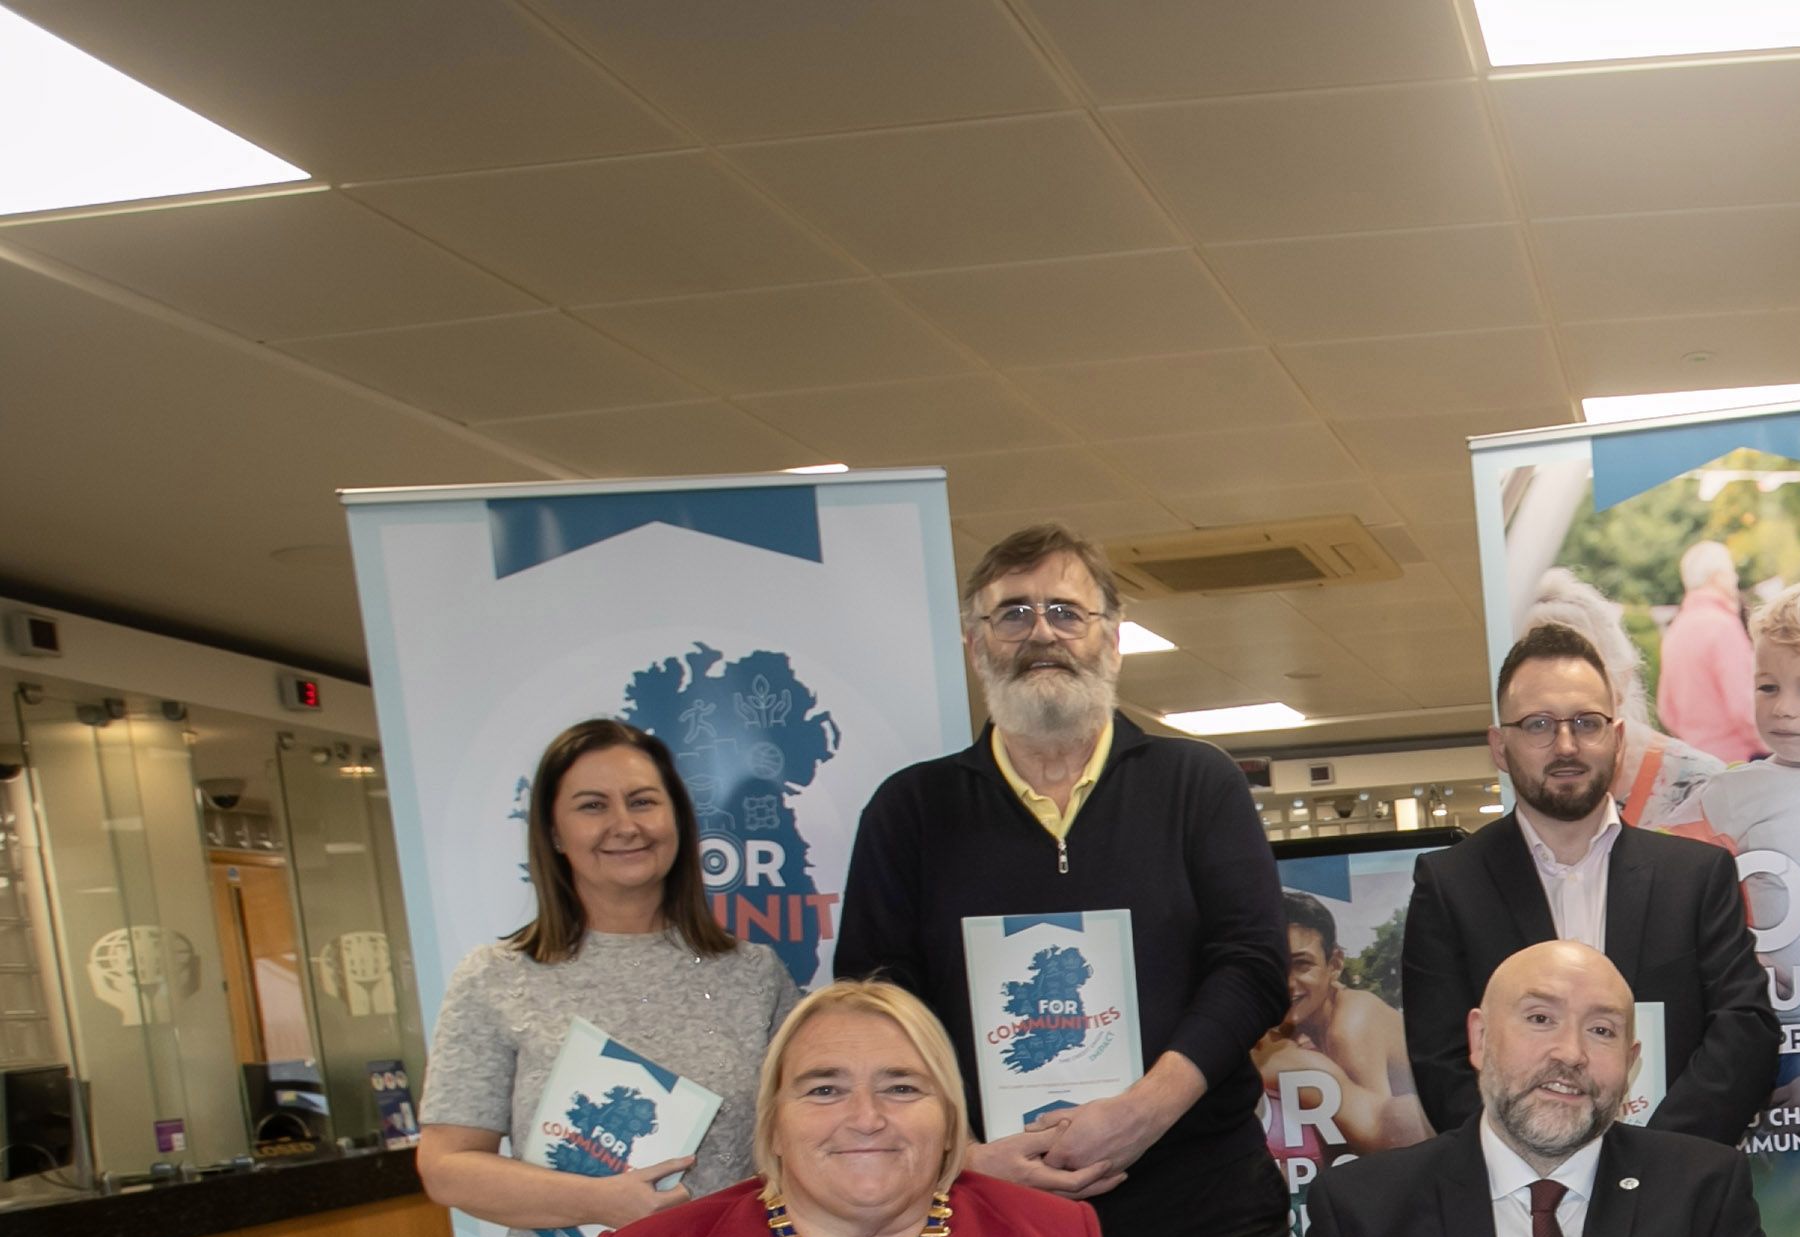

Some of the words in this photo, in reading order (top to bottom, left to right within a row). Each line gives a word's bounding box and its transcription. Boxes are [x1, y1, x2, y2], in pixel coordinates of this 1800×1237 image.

[1038, 999, 1078, 1015] FOR
[987, 1006, 1121, 1045] COMMUNITIES
[591, 1126, 628, 1157] FOR
